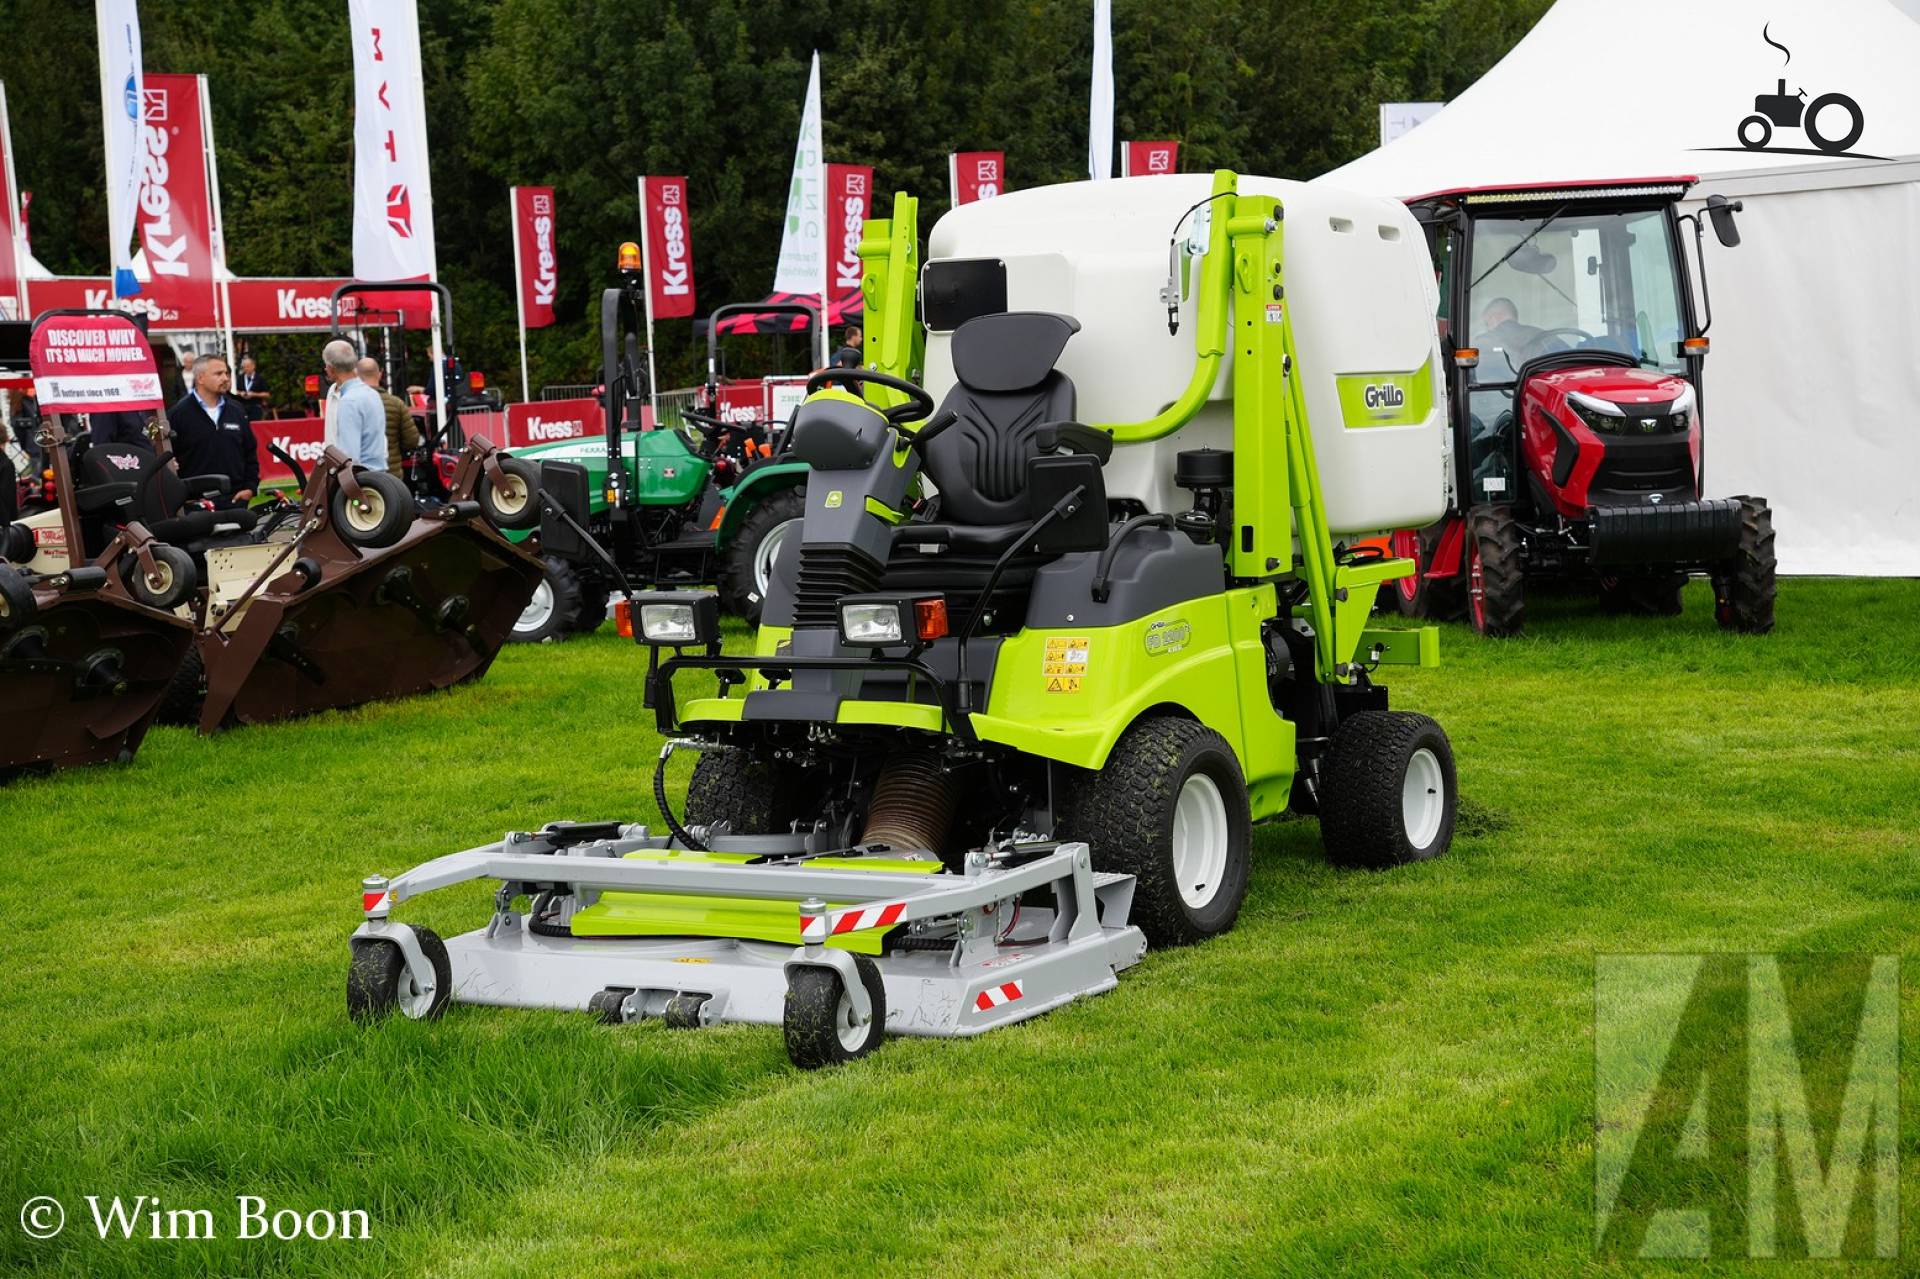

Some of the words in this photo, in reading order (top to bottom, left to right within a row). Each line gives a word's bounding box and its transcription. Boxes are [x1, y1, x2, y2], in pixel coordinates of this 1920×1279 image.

[663, 206, 689, 295] Kress
[837, 196, 864, 288] Kress
[534, 216, 557, 305] Kress
[48, 329, 106, 346] DISCOVER
[107, 329, 135, 345] WHY
[64, 348, 76, 363] SO
[77, 348, 105, 362] MUCH
[1364, 383, 1405, 409] Grillo
[720, 402, 755, 422] Kress
[527, 417, 572, 440] Kress
